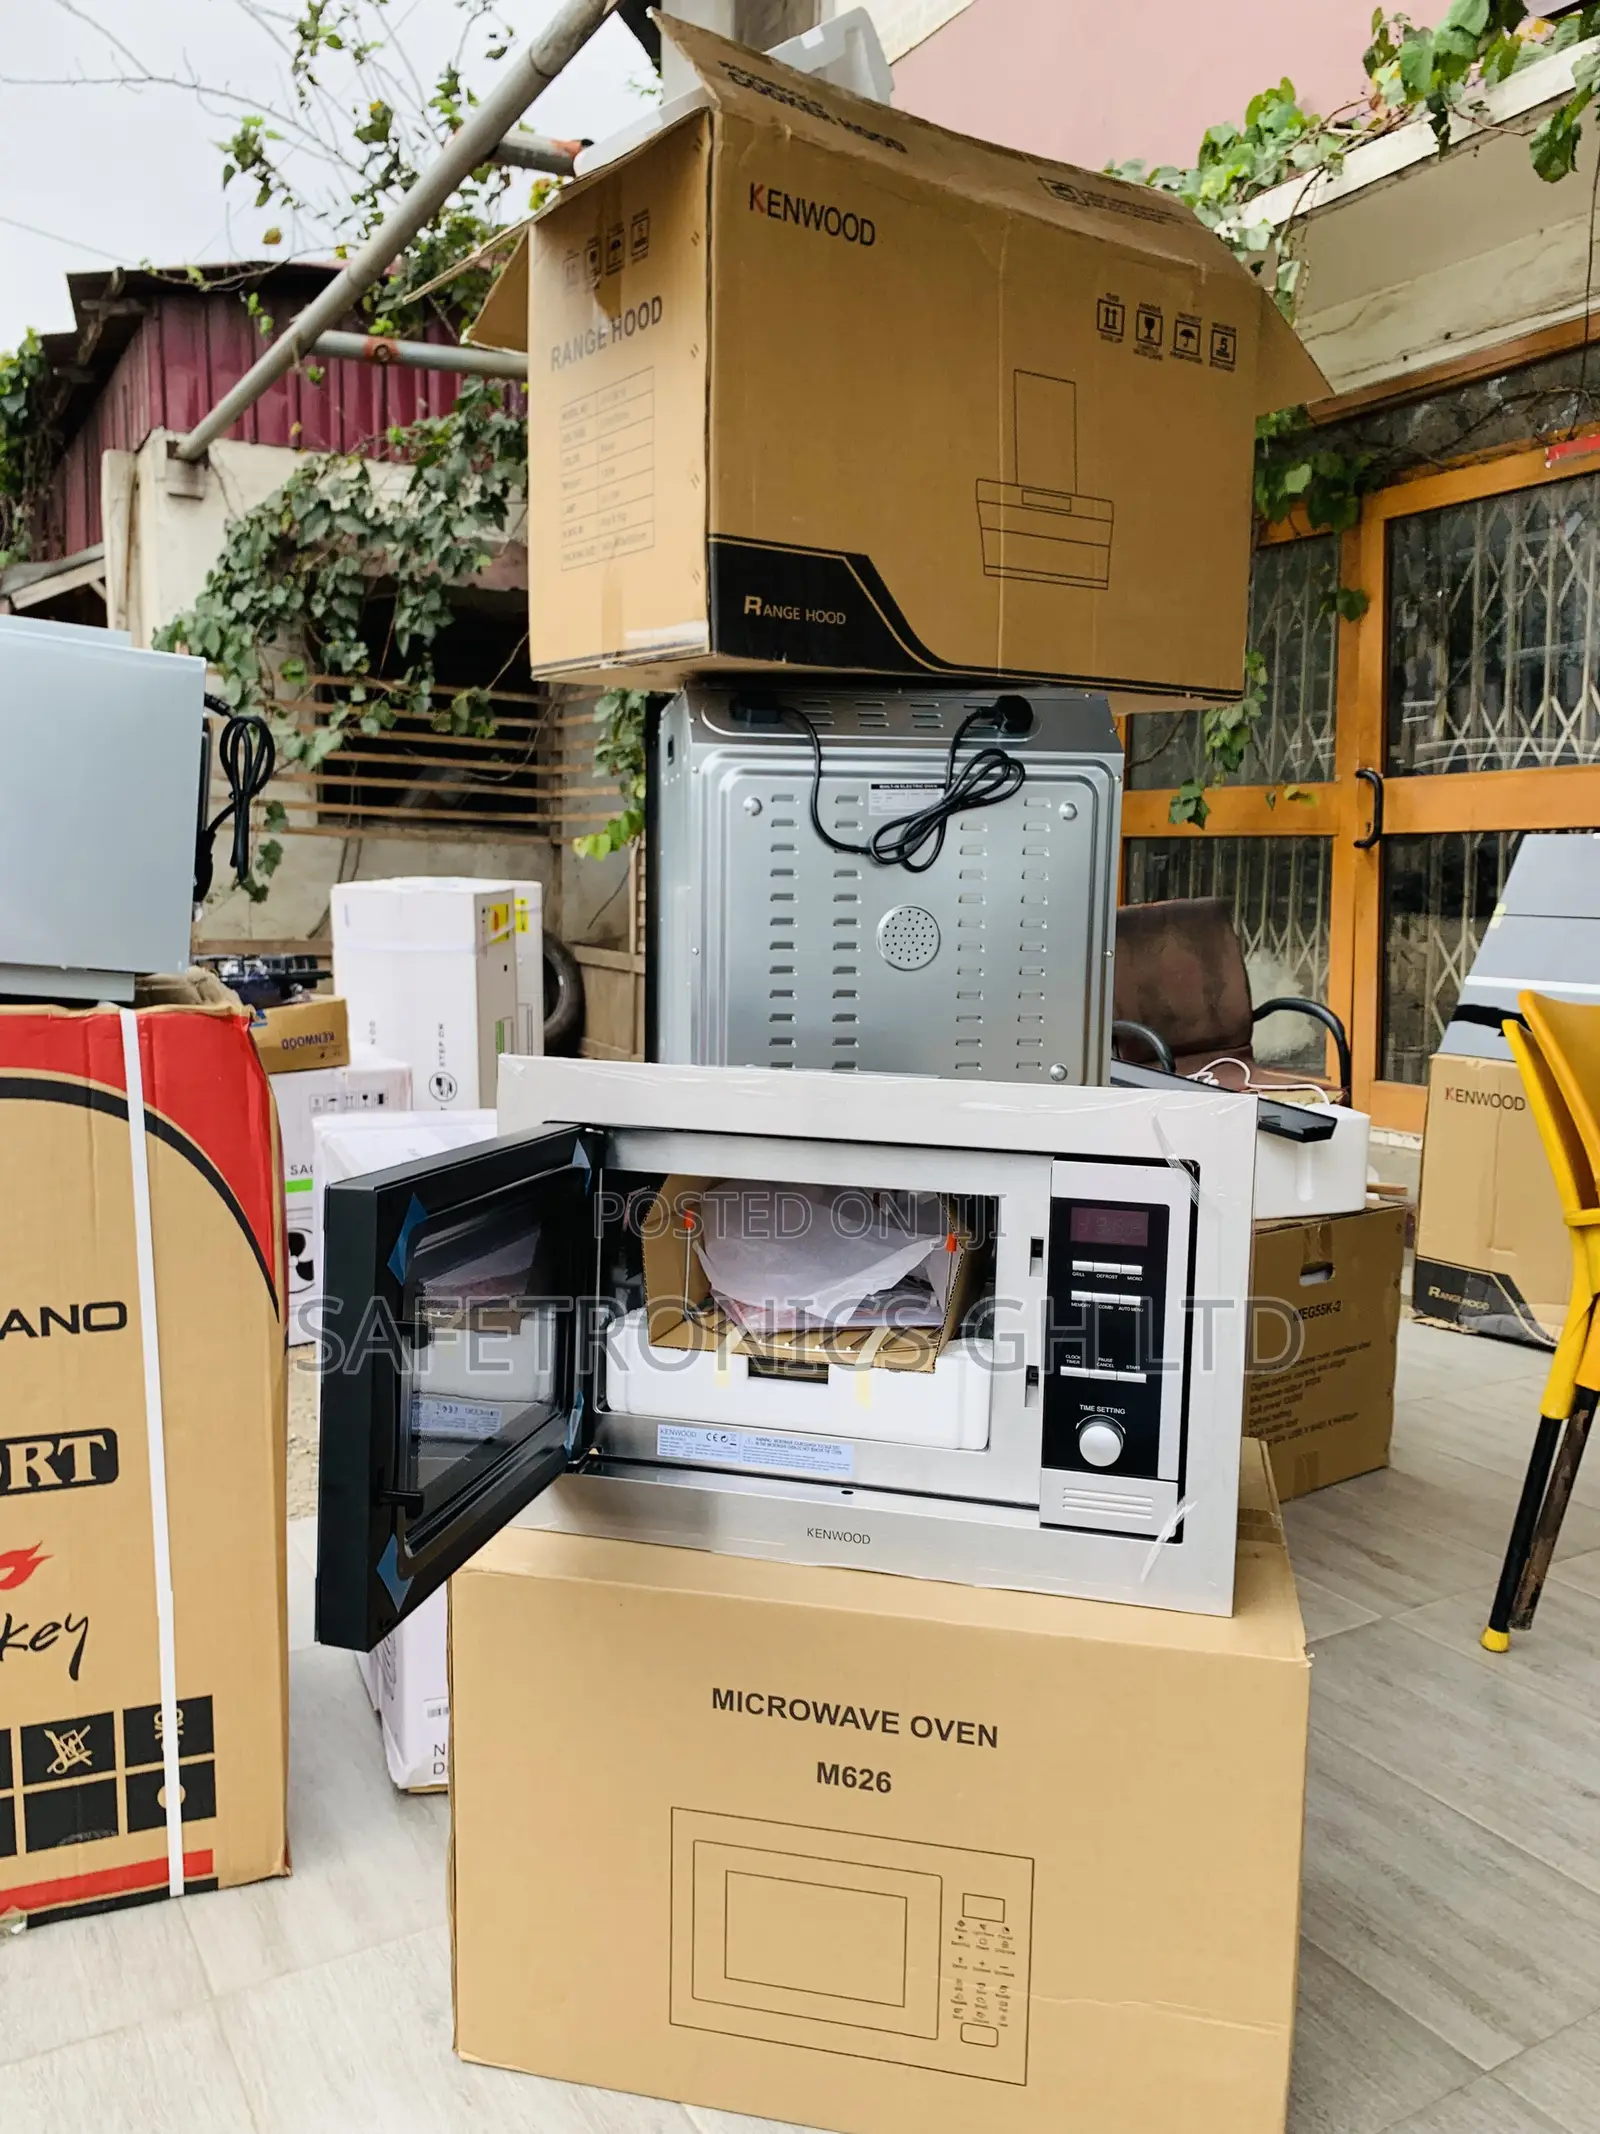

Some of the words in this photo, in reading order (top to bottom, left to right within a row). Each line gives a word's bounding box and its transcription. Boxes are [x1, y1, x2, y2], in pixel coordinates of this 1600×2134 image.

[749, 181, 876, 246] KENWOOD
[550, 328, 607, 372] RANGE
[611, 295, 663, 343] HOOD
[744, 594, 800, 620] RANGE
[805, 609, 846, 625] HOOD
[281, 1031, 335, 1051] KENWOOD
[1444, 1086, 1526, 1112] KENWOOD
[1080, 1404, 1095, 1412] TIME
[1096, 1406, 1126, 1414] SETTING
[660, 1428, 697, 1438] KENWOOD
[0, 1434, 107, 1490] RT
[806, 1527, 871, 1545] KENWOOD
[711, 1687, 901, 1736] MICROWAVE
[909, 1714, 999, 1749] OVEN
[815, 1760, 893, 1794] M626
